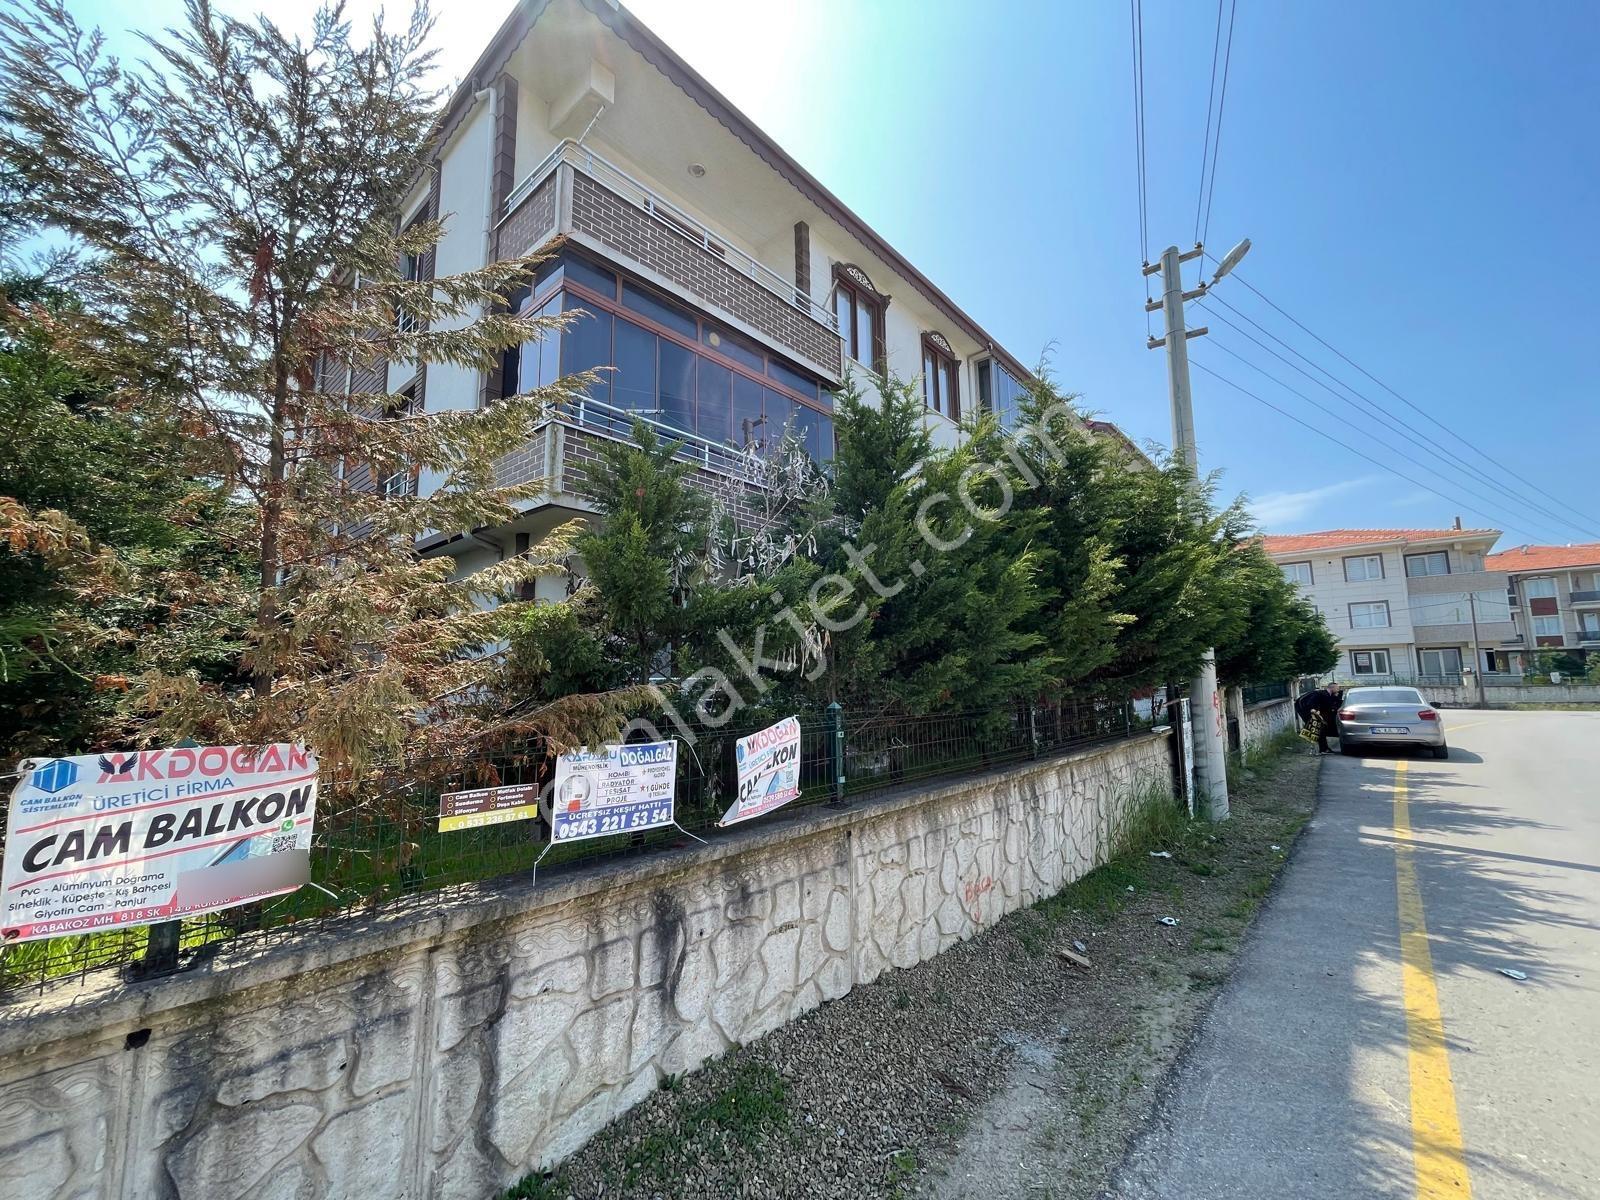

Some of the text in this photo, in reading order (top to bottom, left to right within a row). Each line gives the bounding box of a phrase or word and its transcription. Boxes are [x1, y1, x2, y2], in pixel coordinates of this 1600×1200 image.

[764, 743, 797, 770] KON
[20, 793, 83, 806] CAM BALKON
[93, 777, 234, 811] ÜRETİCİ FİRMA
[638, 802, 661, 810] HATTI
[22, 785, 312, 873] CAM BALKON
[559, 808, 668, 839] 0543 221 53 54
[8, 898, 51, 911] Sineklik
[62, 892, 105, 904] Küpeşte
[132, 882, 171, 894] Bahçesi
[20, 888, 40, 898] Pvc
[51, 878, 112, 892] Alüminyum
[34, 896, 147, 919] Giyotin Cam Panjur
[32, 918, 90, 934] KABAKOZ
[121, 911, 143, 921] 818
